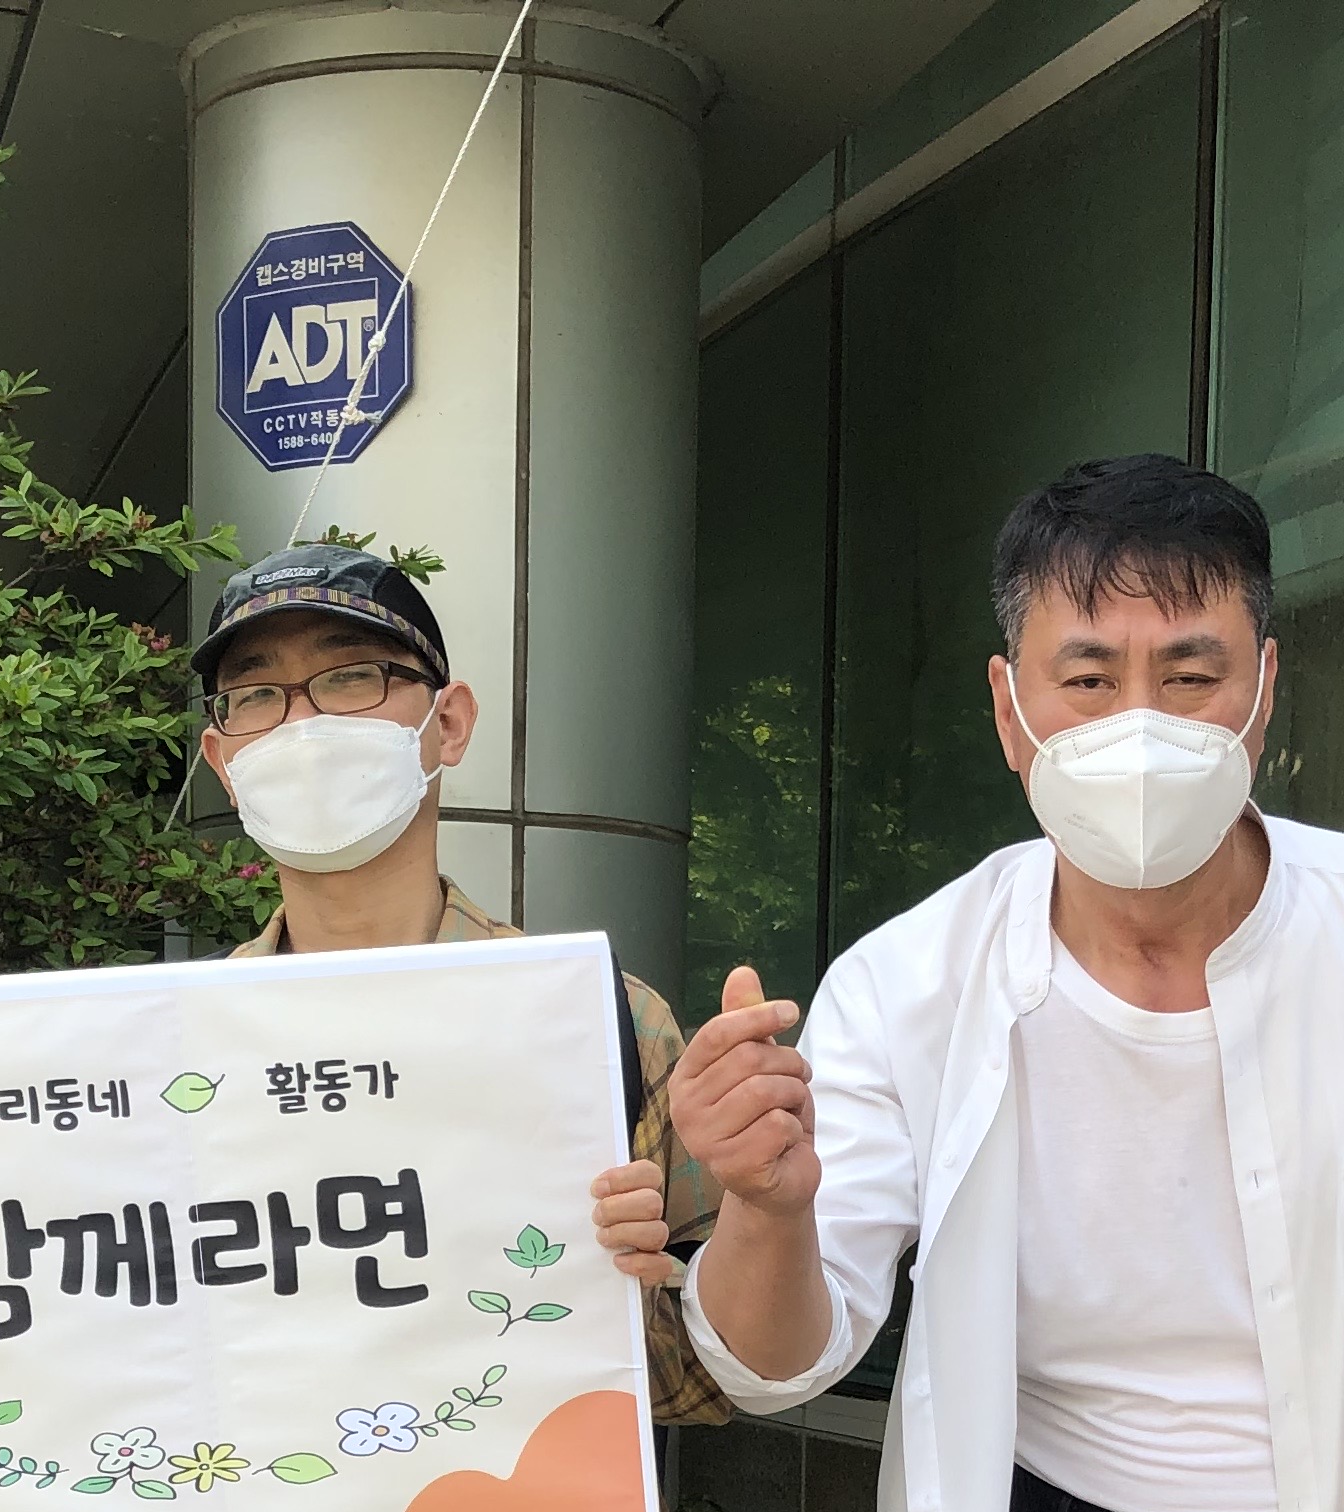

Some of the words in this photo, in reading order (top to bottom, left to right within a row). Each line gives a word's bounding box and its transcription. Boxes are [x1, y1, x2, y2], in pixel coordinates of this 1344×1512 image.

[256, 251, 364, 286] 캡스경비구역
[247, 299, 377, 394] ADT
[263, 408, 346, 433] CCTV작동
[265, 1059, 399, 1114] 활동가
